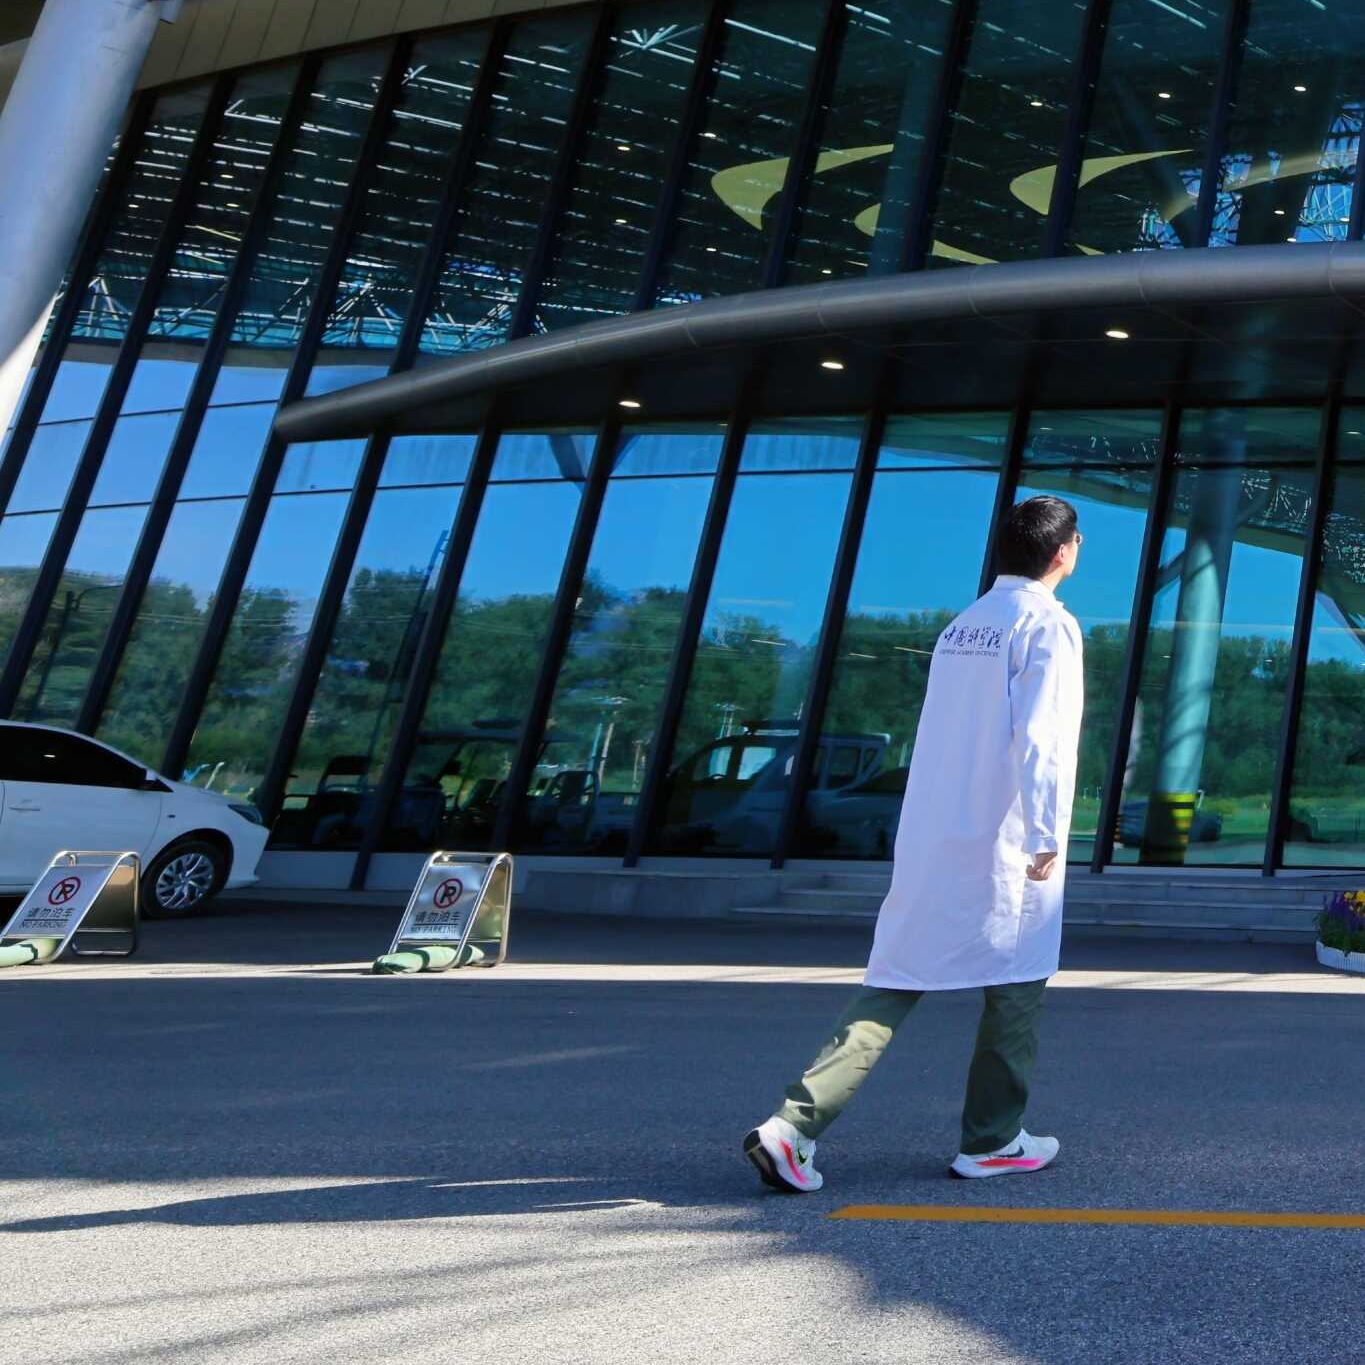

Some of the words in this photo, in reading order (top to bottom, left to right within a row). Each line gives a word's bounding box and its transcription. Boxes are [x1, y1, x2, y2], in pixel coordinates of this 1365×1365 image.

[27, 907, 75, 918] 请勿泊车
[415, 910, 462, 923] 请勿泊车
